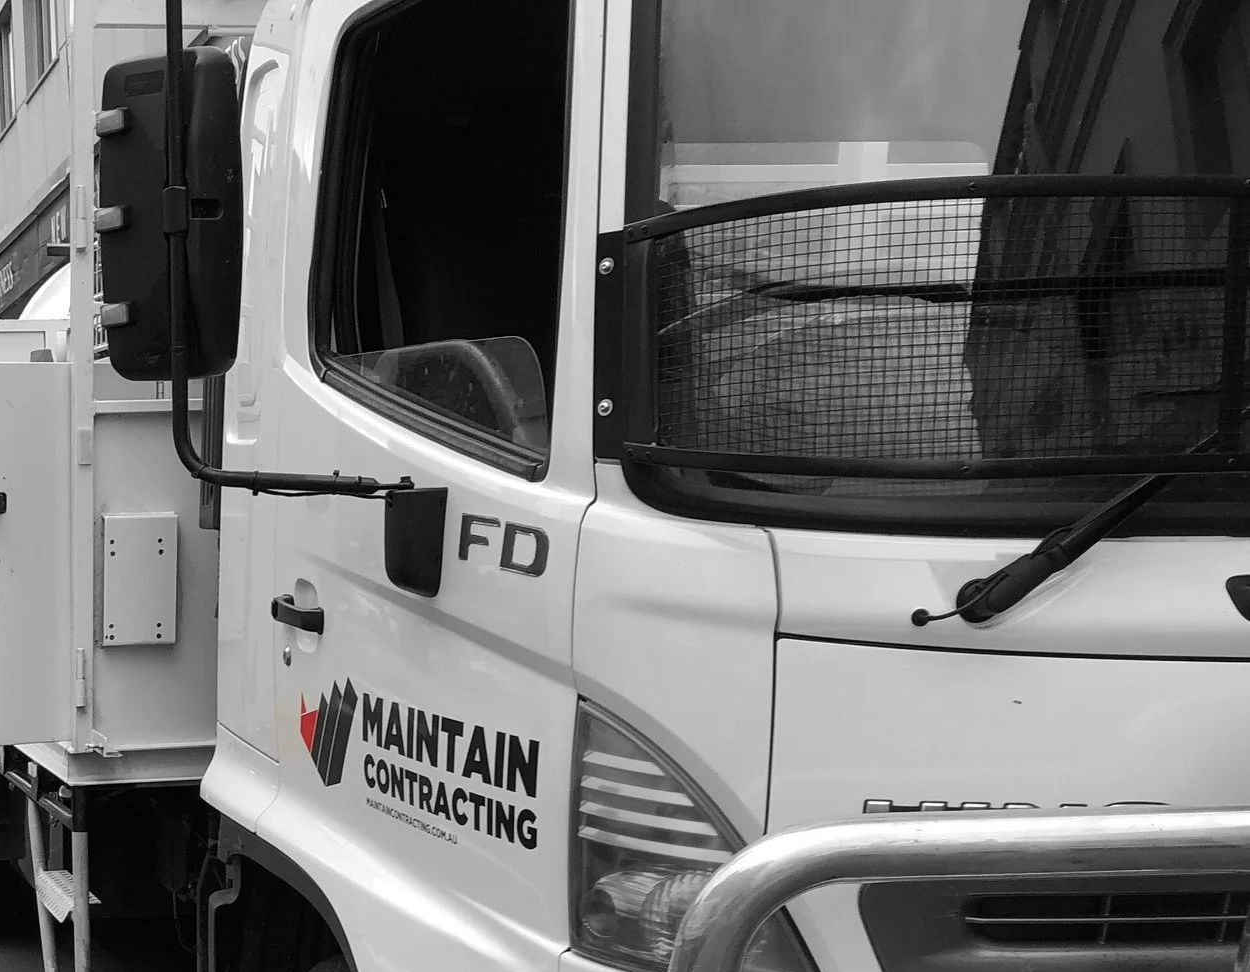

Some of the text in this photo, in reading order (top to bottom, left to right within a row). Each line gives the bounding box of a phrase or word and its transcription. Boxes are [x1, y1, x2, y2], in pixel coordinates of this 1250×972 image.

[458, 512, 550, 578] FD
[362, 693, 540, 798] MAINTAIN
[364, 754, 537, 850] CONTRACTING
[366, 797, 458, 845] MAINTAINCONTRACTING.COM.AU
